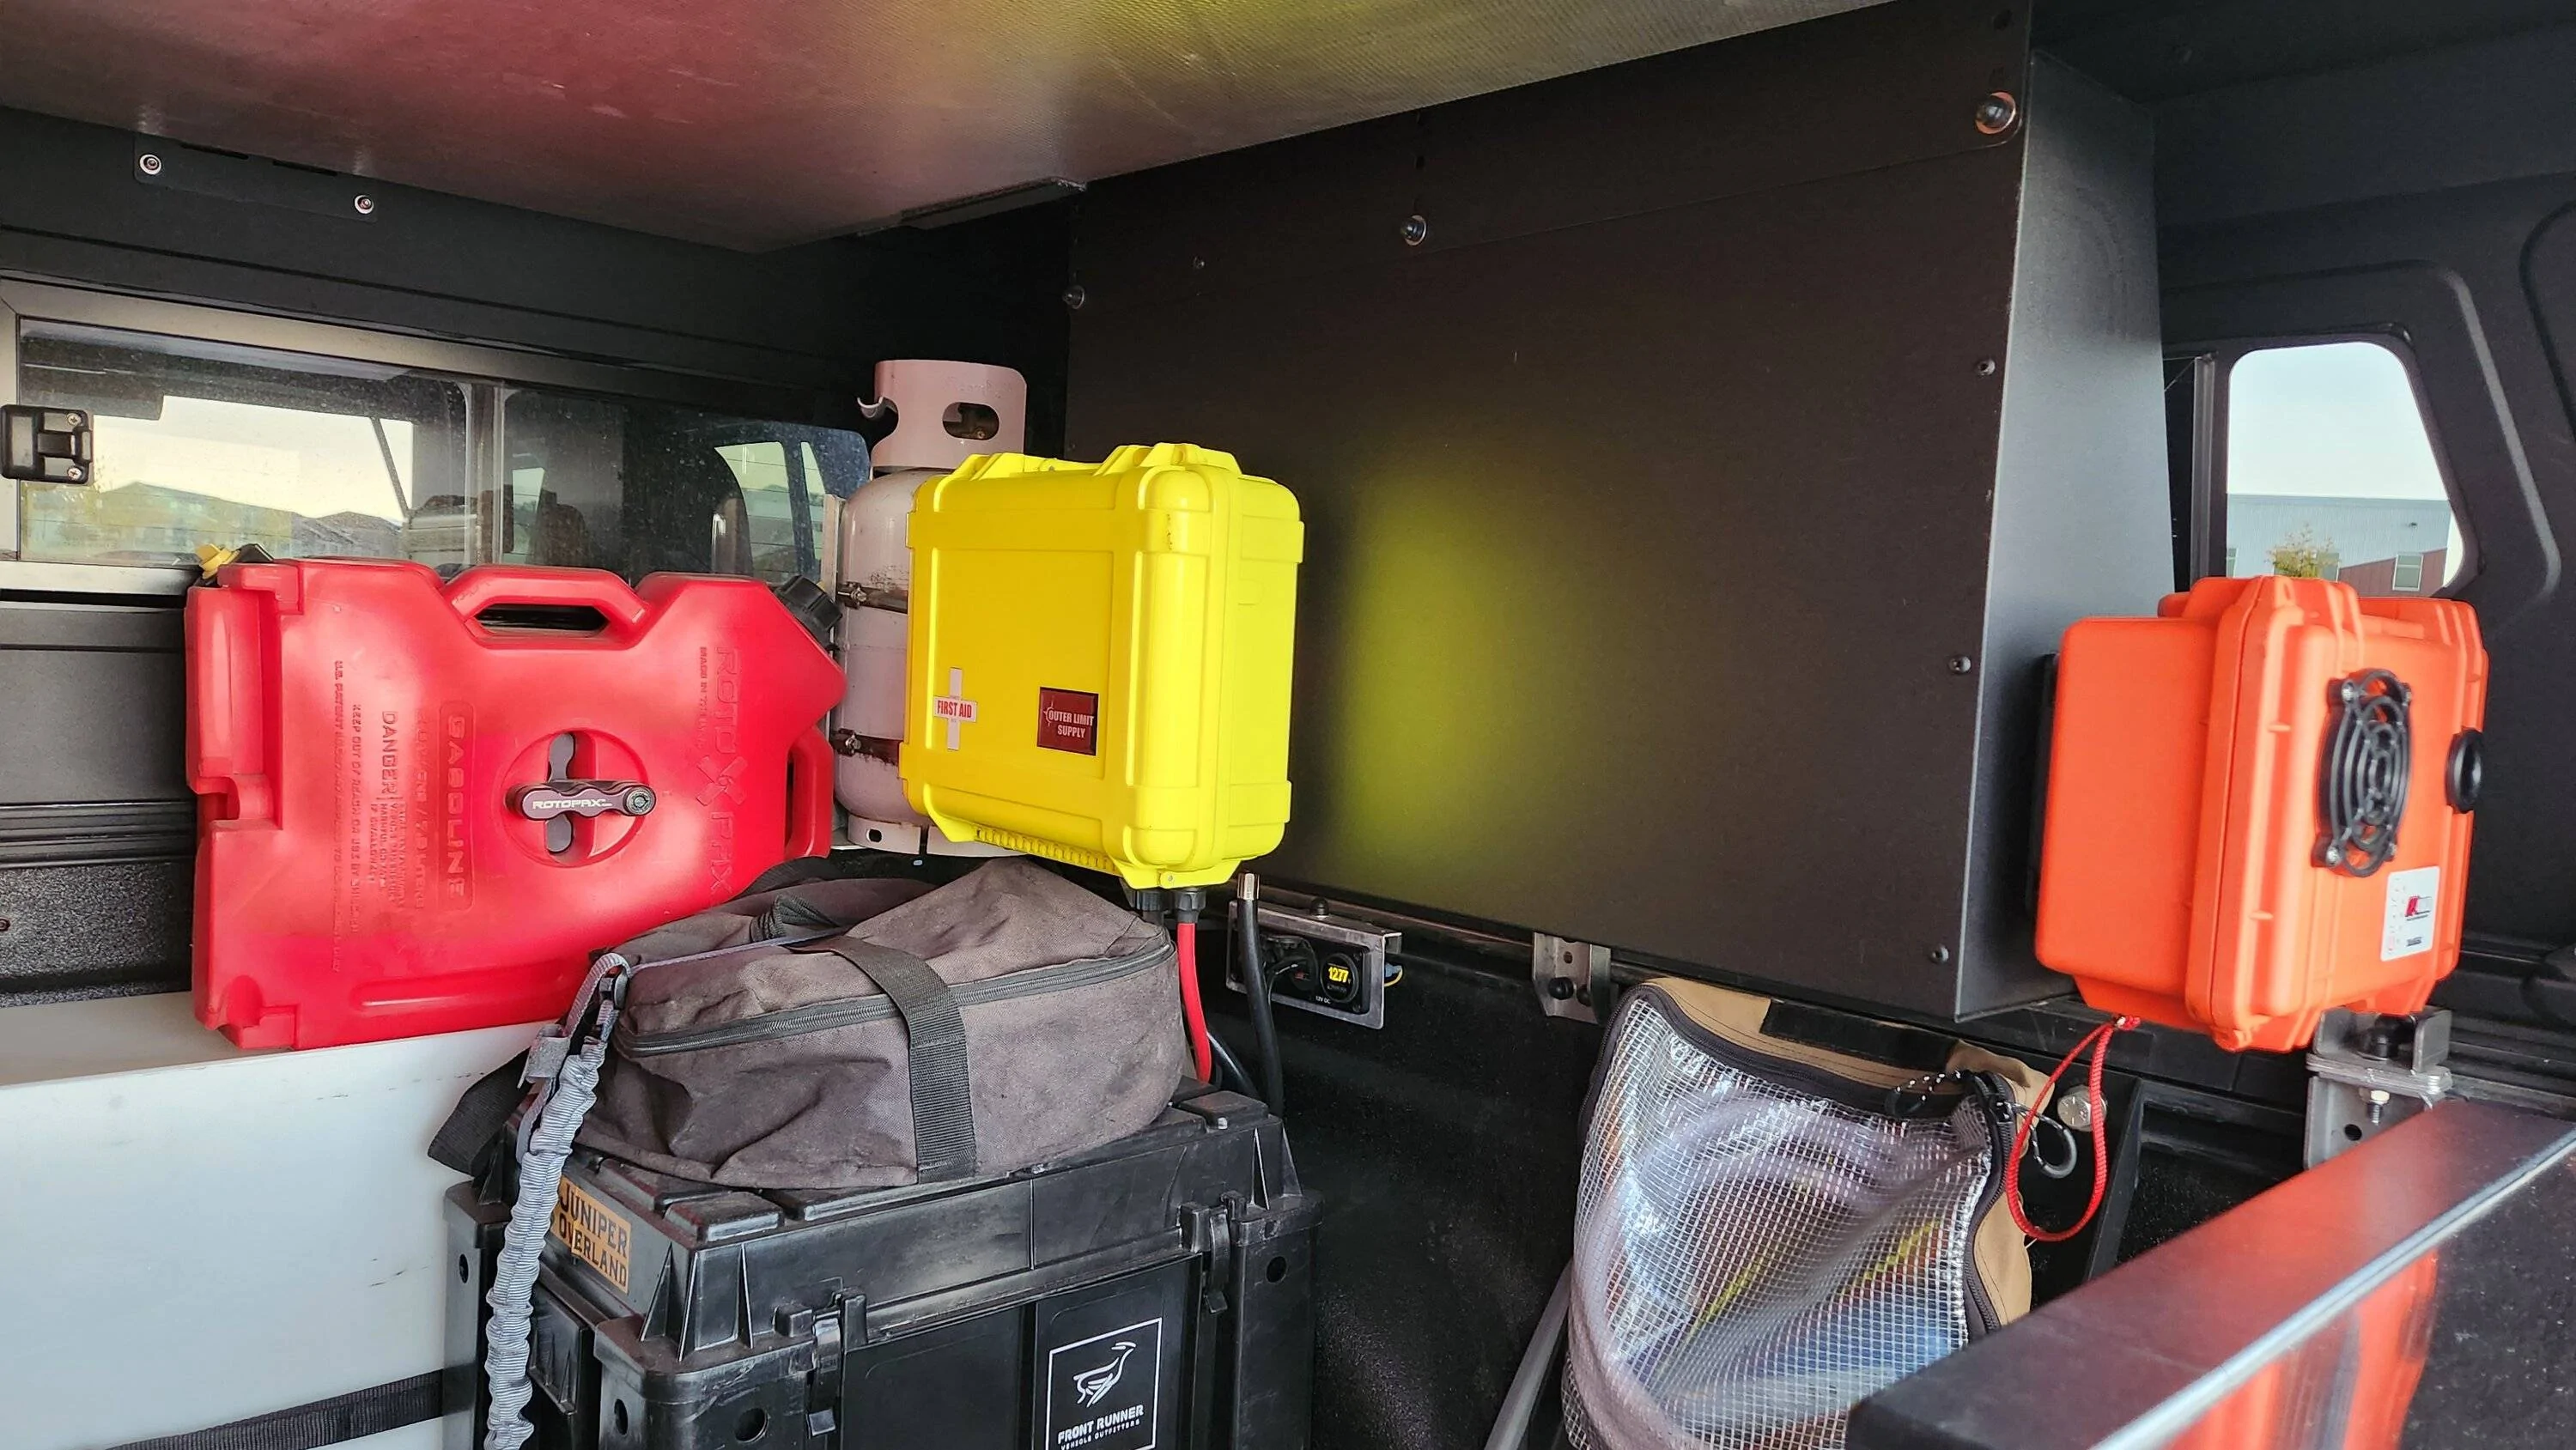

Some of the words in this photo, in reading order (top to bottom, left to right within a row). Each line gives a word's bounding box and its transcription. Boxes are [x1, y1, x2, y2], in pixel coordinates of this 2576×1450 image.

[352, 704, 361, 732] KEEP
[937, 700, 957, 716] FIRST
[959, 703, 972, 719] AID
[1049, 710, 1072, 724] OUTER
[1073, 713, 1095, 726] LIMIT
[352, 736, 361, 757] OUT
[1057, 725, 1085, 738] SUPPLY
[381, 710, 398, 795] DANGER
[447, 715, 465, 899] GASOLINE
[532, 799, 605, 809] ROTOPAX
[560, 1182, 628, 1259] JUNIPER
[559, 1212, 628, 1288] OVERLAND
[1057, 1420, 1095, 1445] FRONT
[1097, 1404, 1145, 1430] RUNNER
[1060, 1436, 1092, 1450] VEHICLE
[1094, 1418, 1140, 1440] OUTFITTERS
